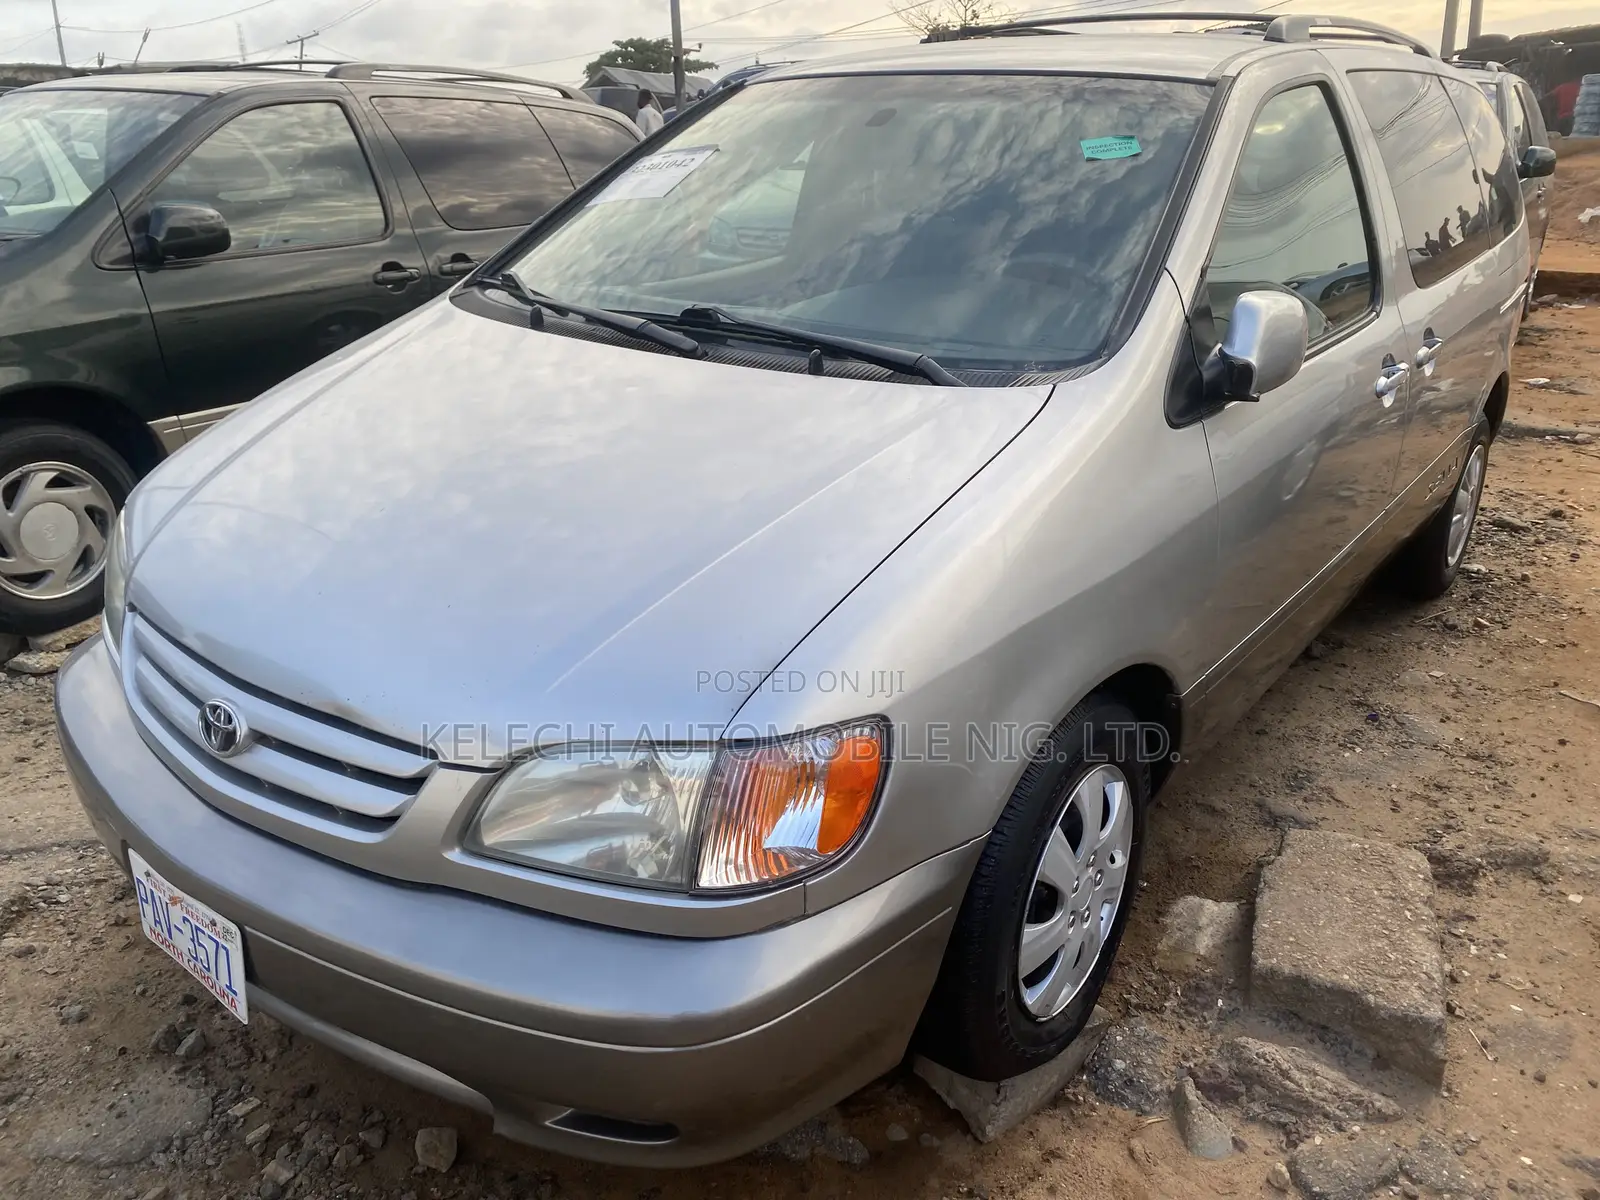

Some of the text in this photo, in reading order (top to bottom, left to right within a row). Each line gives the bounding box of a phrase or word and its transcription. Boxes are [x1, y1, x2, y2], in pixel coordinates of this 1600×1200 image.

[1086, 140, 1133, 150] INSPECTION
[1091, 146, 1133, 155] COMPLETE
[136, 876, 238, 997] PAV-3571
[149, 926, 238, 1013] NORTH CAROLINA
